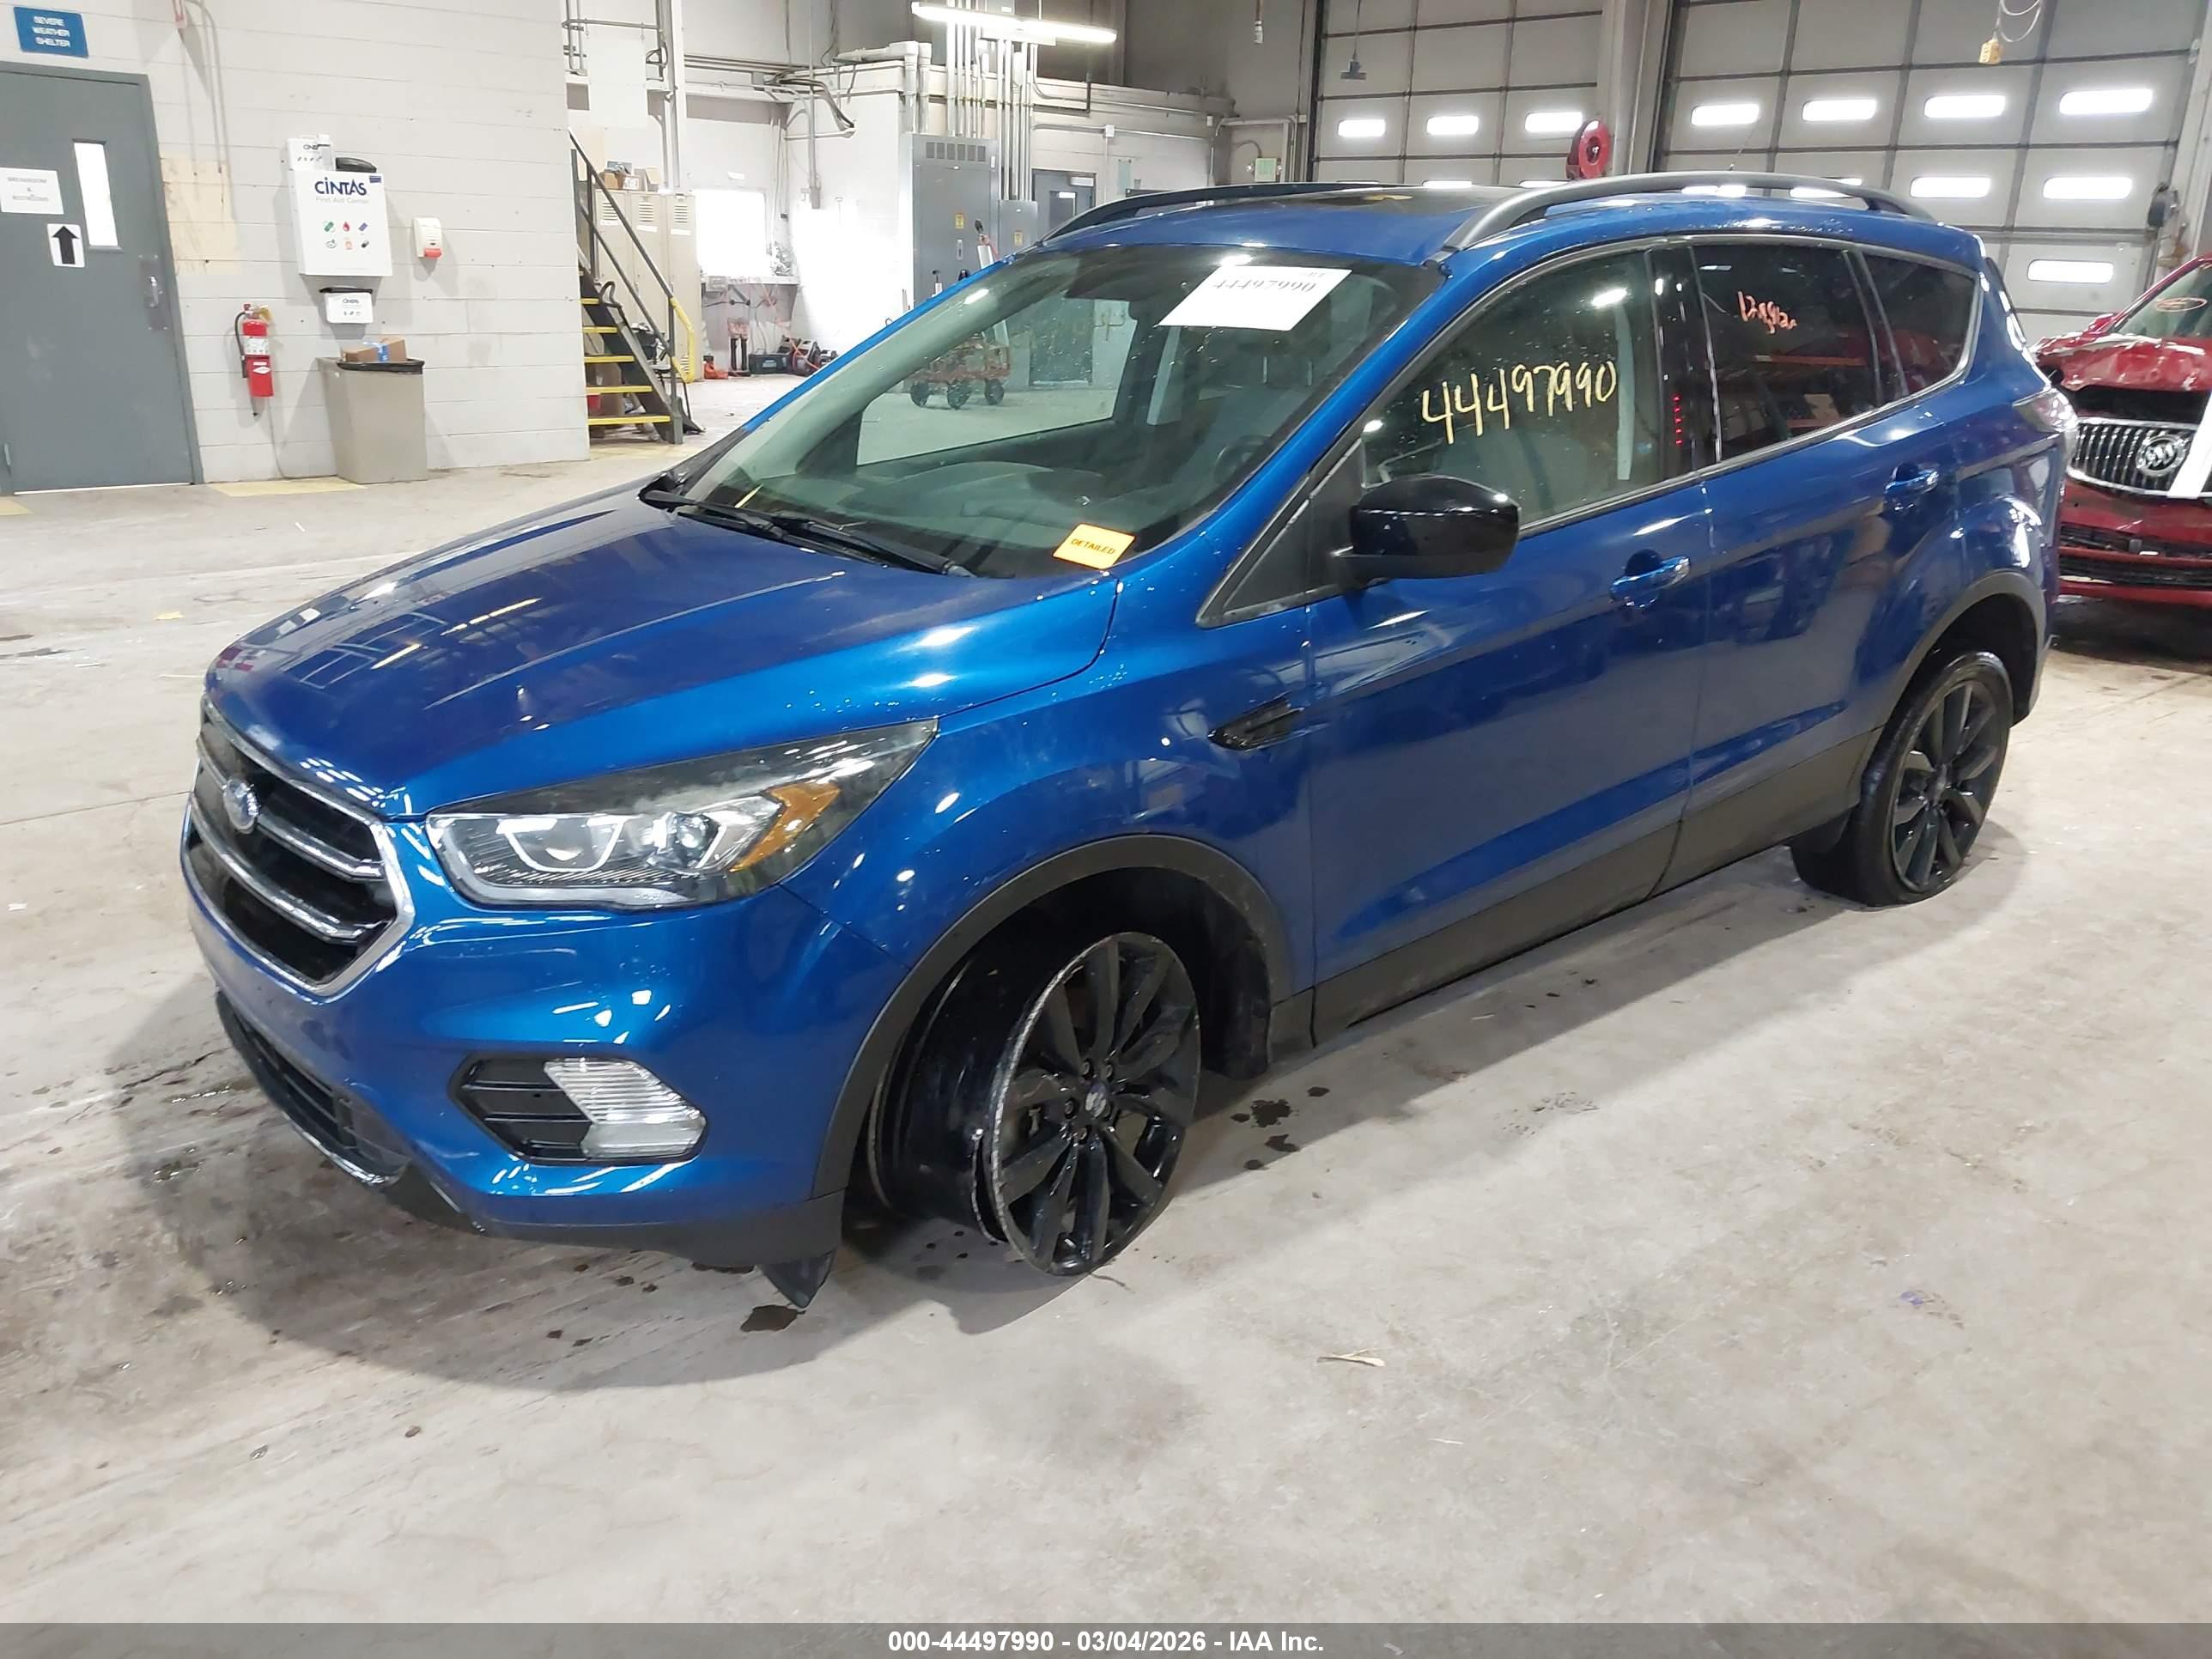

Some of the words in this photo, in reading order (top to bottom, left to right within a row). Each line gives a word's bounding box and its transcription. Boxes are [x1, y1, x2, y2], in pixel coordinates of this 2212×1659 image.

[1212, 278, 1317, 293] 44497990
[1421, 360, 1618, 446] 44497990
[1070, 538, 1116, 556] DETAILED
